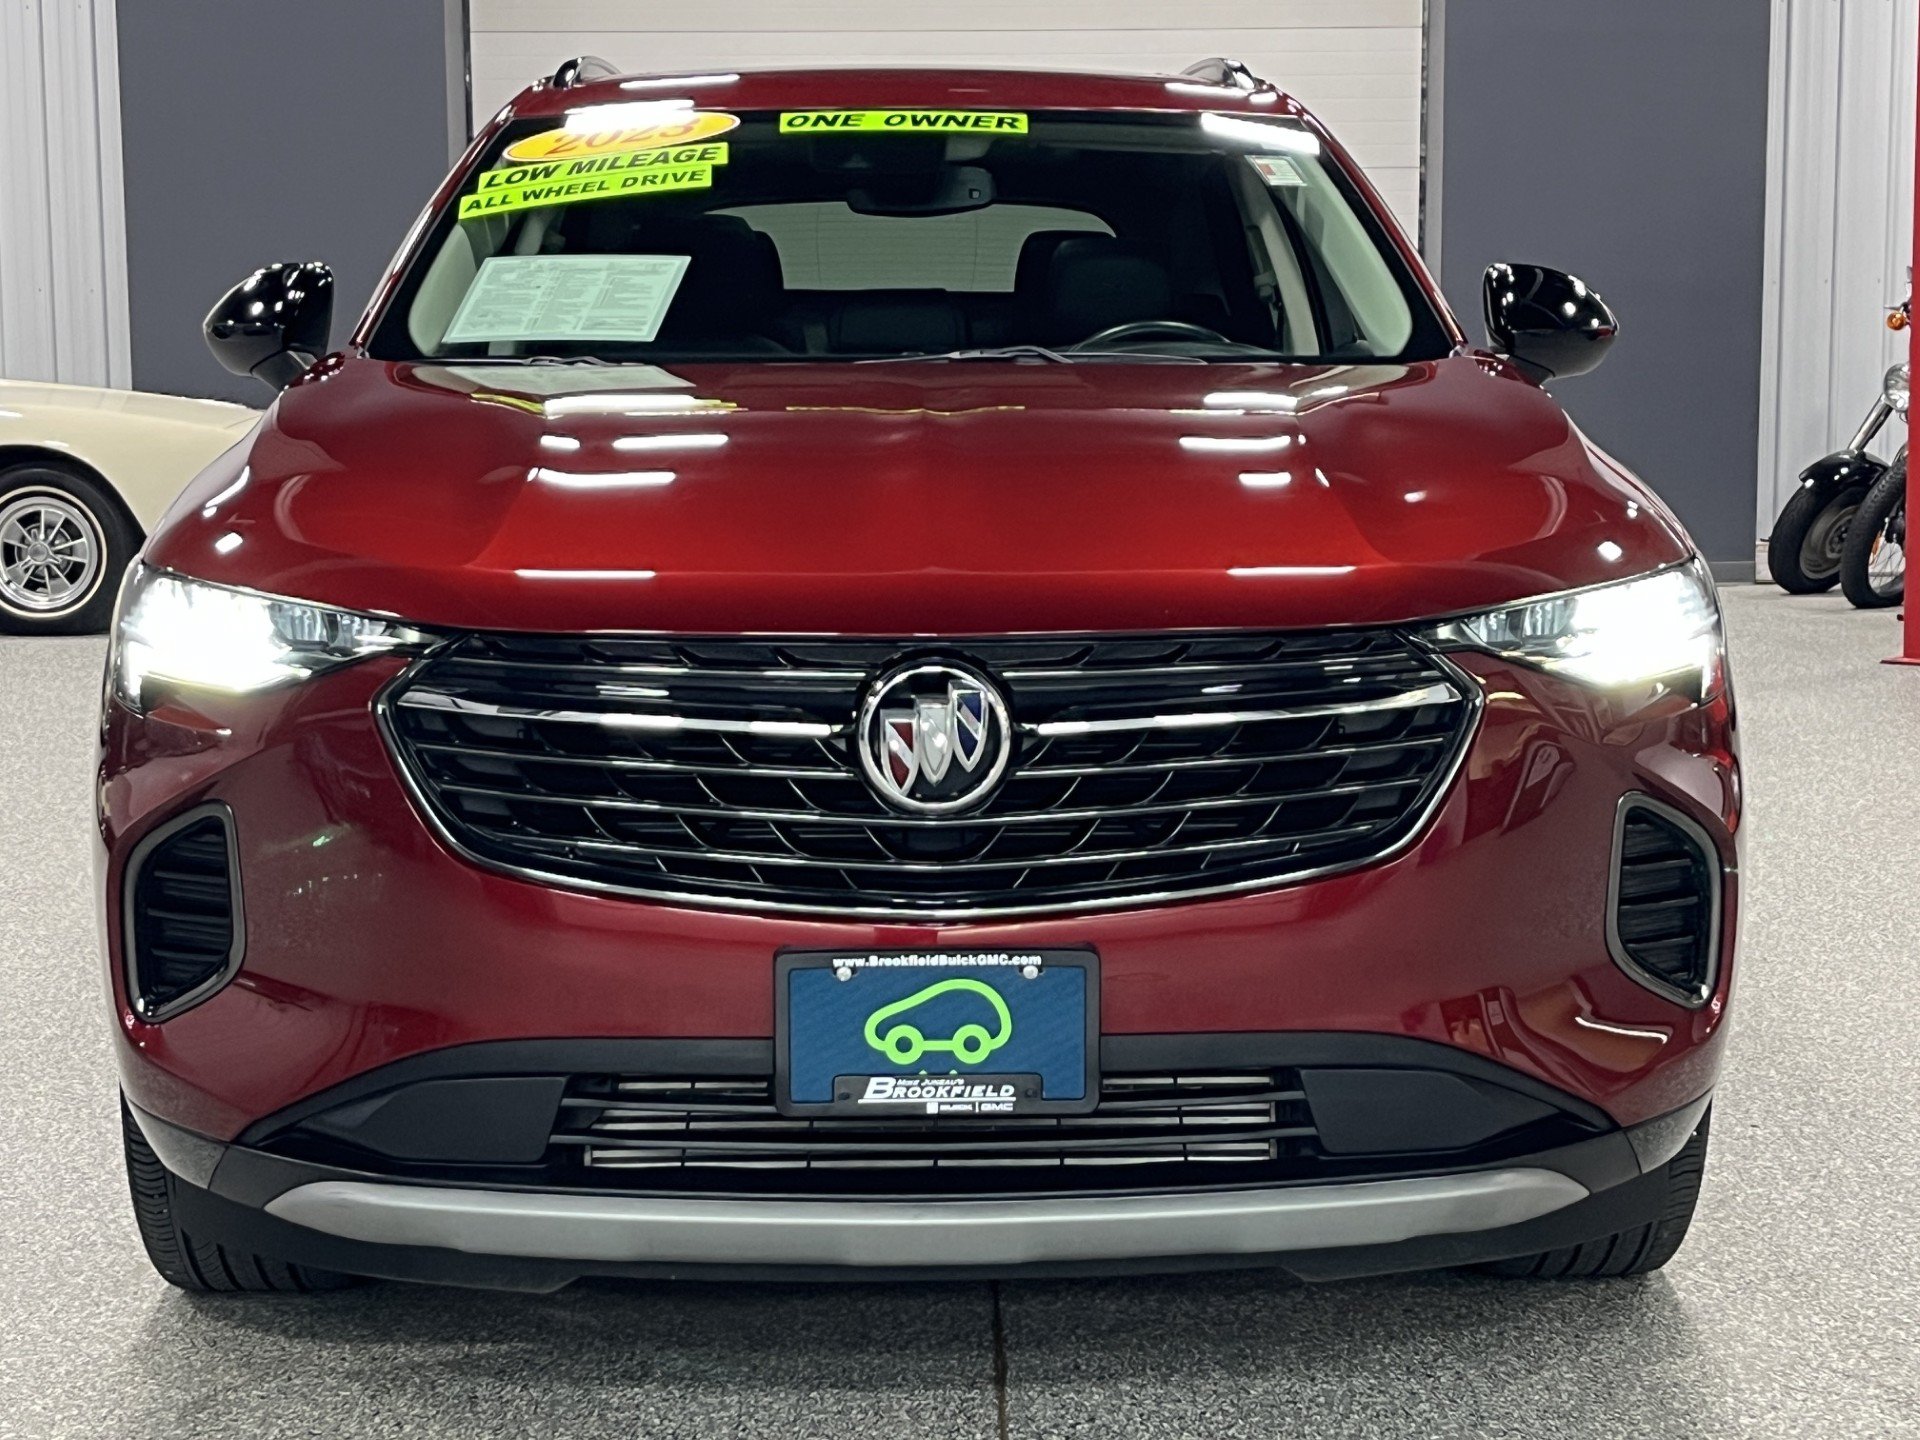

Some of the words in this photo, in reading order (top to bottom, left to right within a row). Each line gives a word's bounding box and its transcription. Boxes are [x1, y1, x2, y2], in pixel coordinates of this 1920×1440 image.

[786, 113, 865, 127] ONE
[884, 114, 1022, 129] OWNER
[483, 165, 559, 189] LOW
[566, 146, 721, 175] MILEAGE
[464, 195, 514, 213] ALL
[522, 180, 611, 202] WHEEL
[620, 169, 707, 189] DRIVE
[832, 954, 1042, 967] www.BrookfieldBuickGMC.com
[864, 1077, 1015, 1098] BROOKFIELD
[980, 1103, 1014, 1111] GMC
